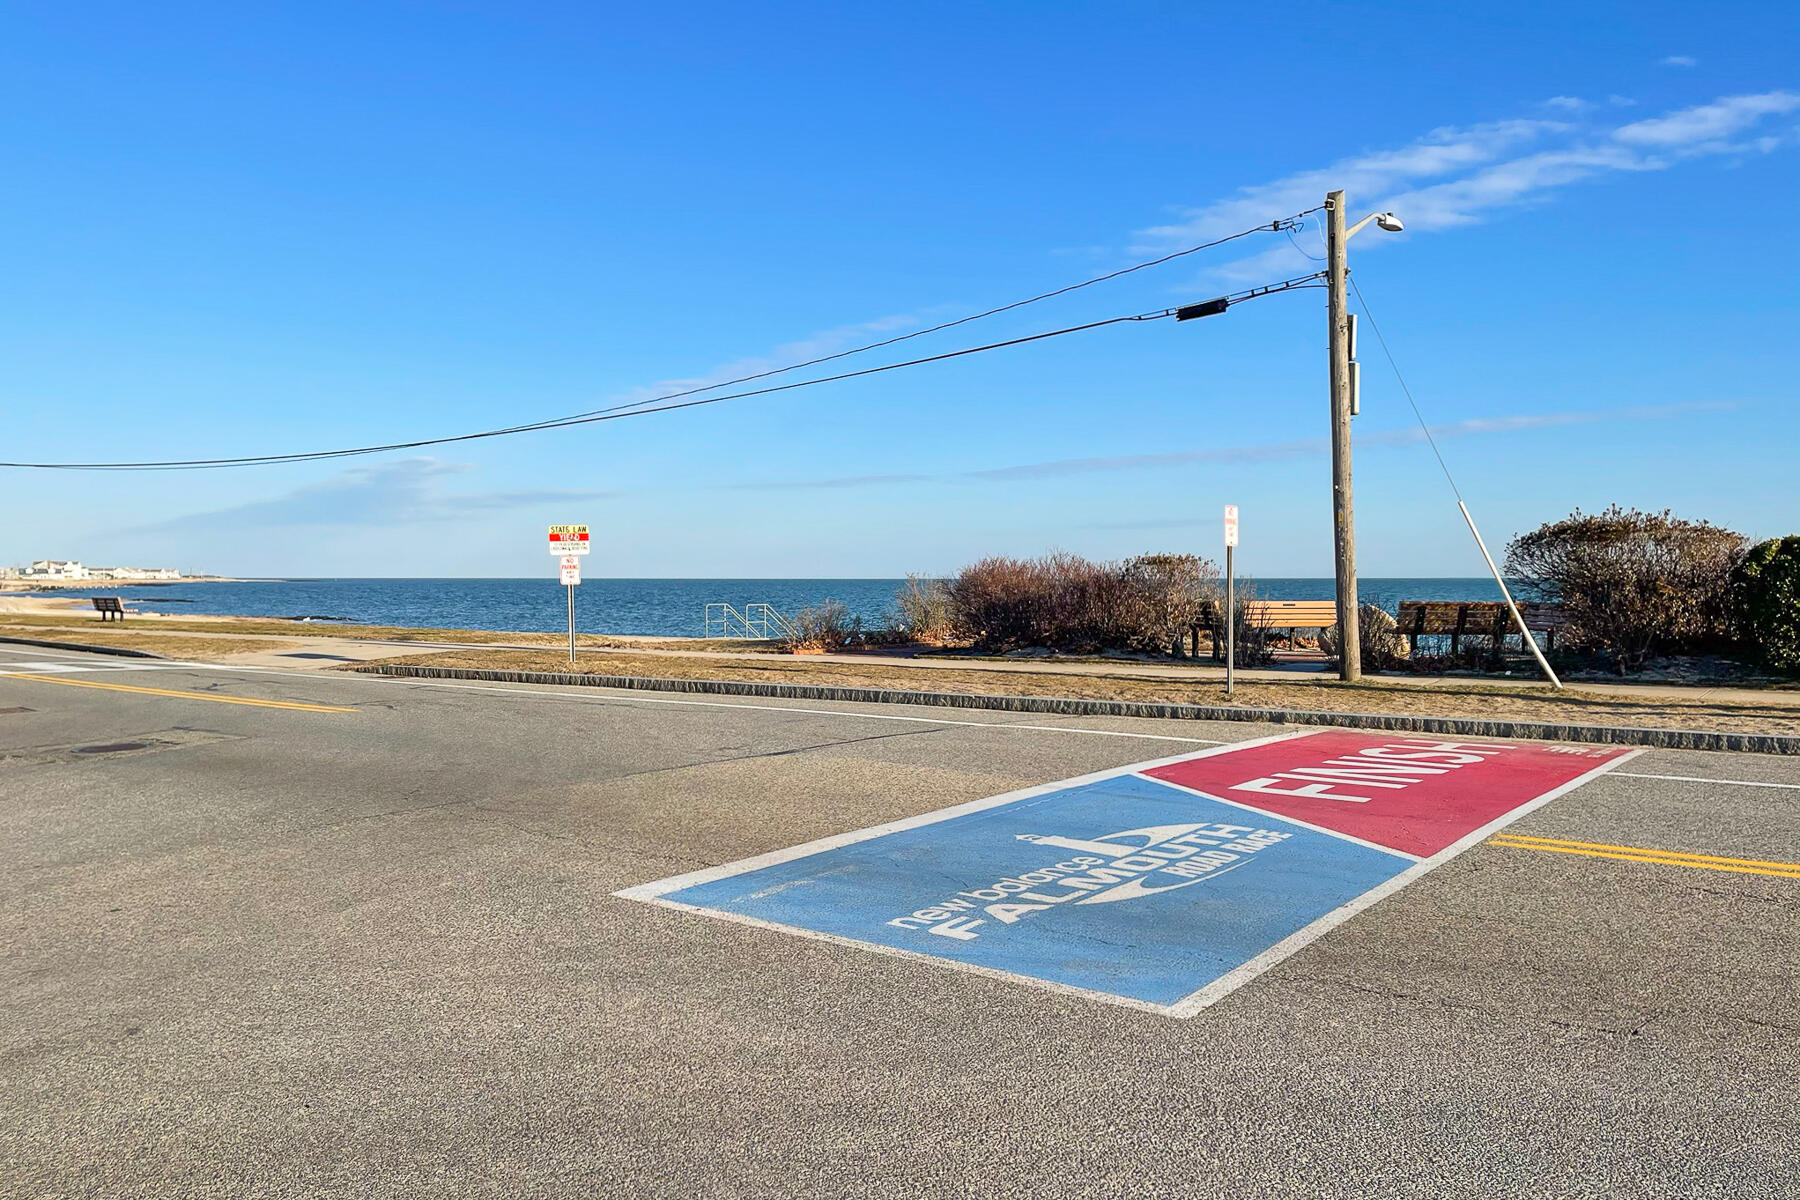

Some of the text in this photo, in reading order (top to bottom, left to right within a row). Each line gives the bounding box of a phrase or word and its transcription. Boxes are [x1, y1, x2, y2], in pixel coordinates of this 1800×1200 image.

[1228, 739, 1517, 803] FINISH
[928, 823, 1257, 941] FALMOUTH
[1159, 828, 1293, 878] ROAD RACE
[886, 855, 1105, 930] new balance
